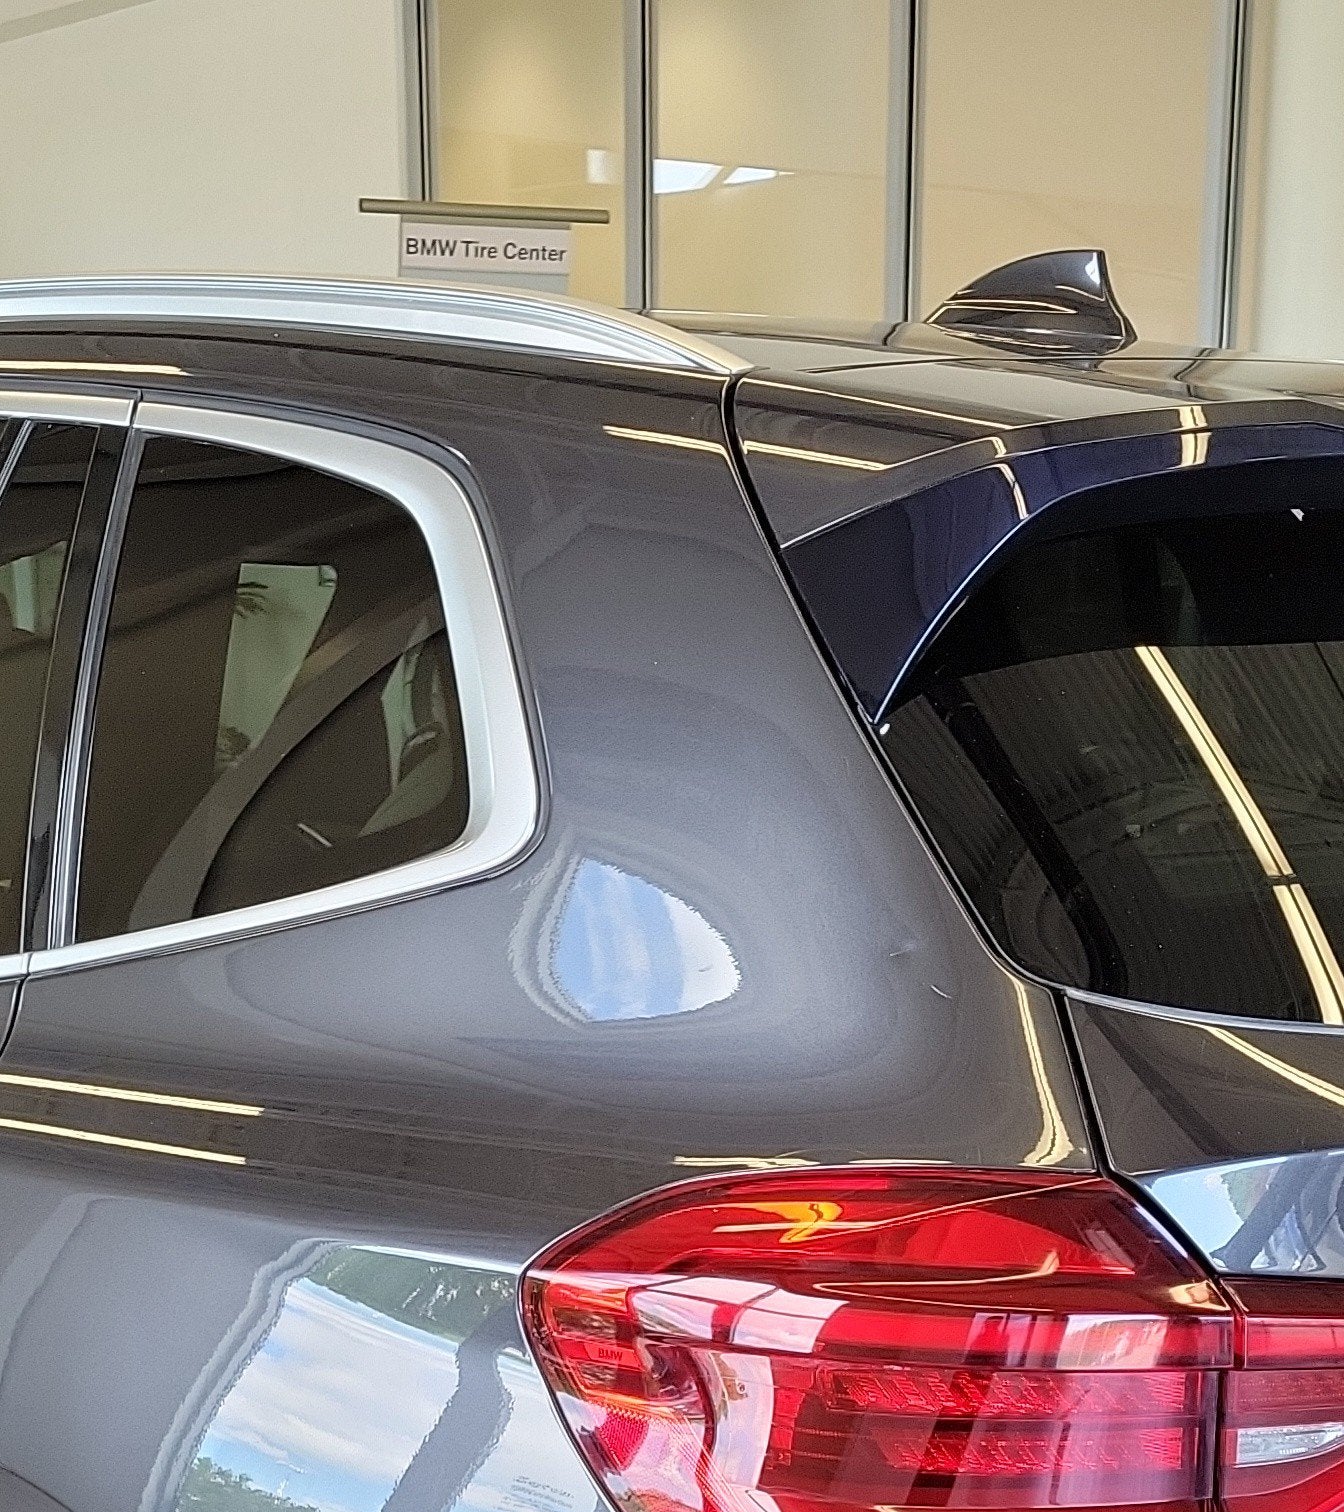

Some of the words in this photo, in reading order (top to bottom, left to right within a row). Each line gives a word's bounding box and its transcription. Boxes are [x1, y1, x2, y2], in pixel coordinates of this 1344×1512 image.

[406, 237, 457, 257] BMW
[460, 239, 497, 259] Tire
[503, 242, 566, 262] Center
